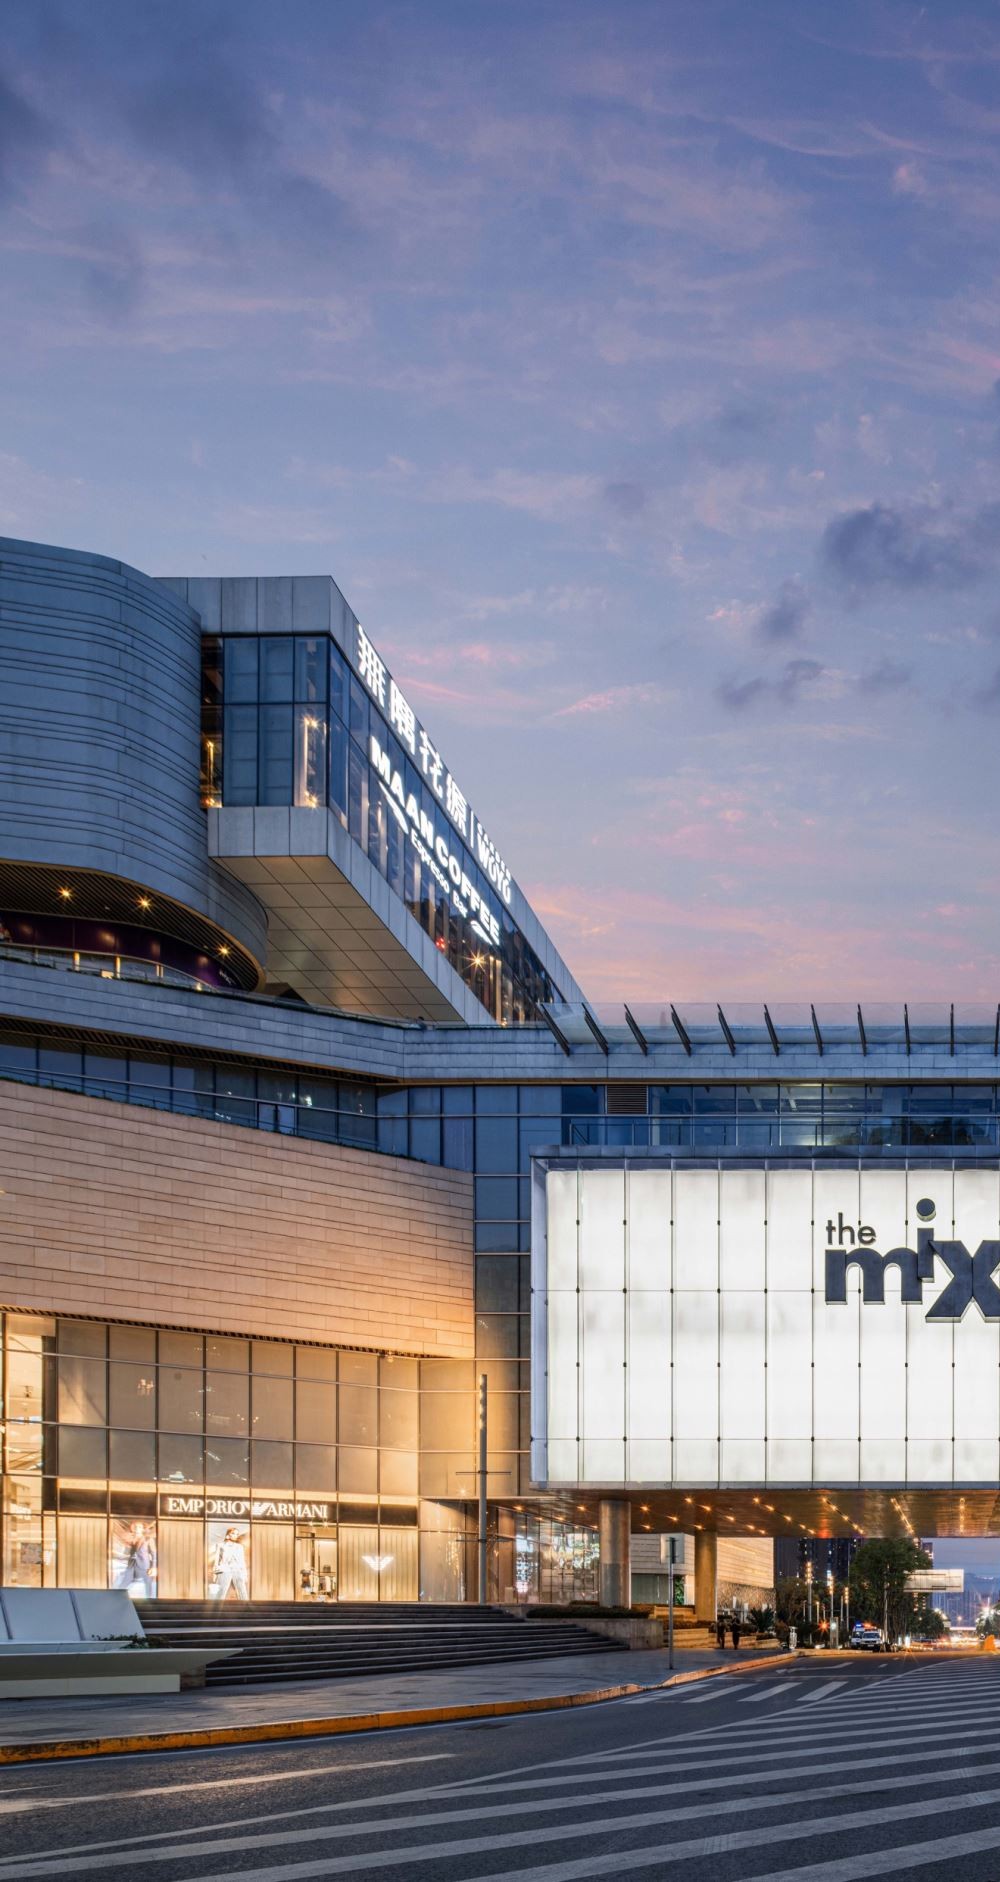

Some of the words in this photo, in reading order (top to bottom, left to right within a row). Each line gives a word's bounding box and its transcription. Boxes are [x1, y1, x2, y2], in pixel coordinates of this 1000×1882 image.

[370, 735, 434, 849] MAAN
[435, 836, 500, 946] COFFEE
[410, 828, 450, 894] Espresso
[452, 890, 469, 918] Bar
[825, 1212, 877, 1245] the
[168, 1496, 247, 1517] EMPORIO
[264, 1501, 329, 1519] ARMANI
